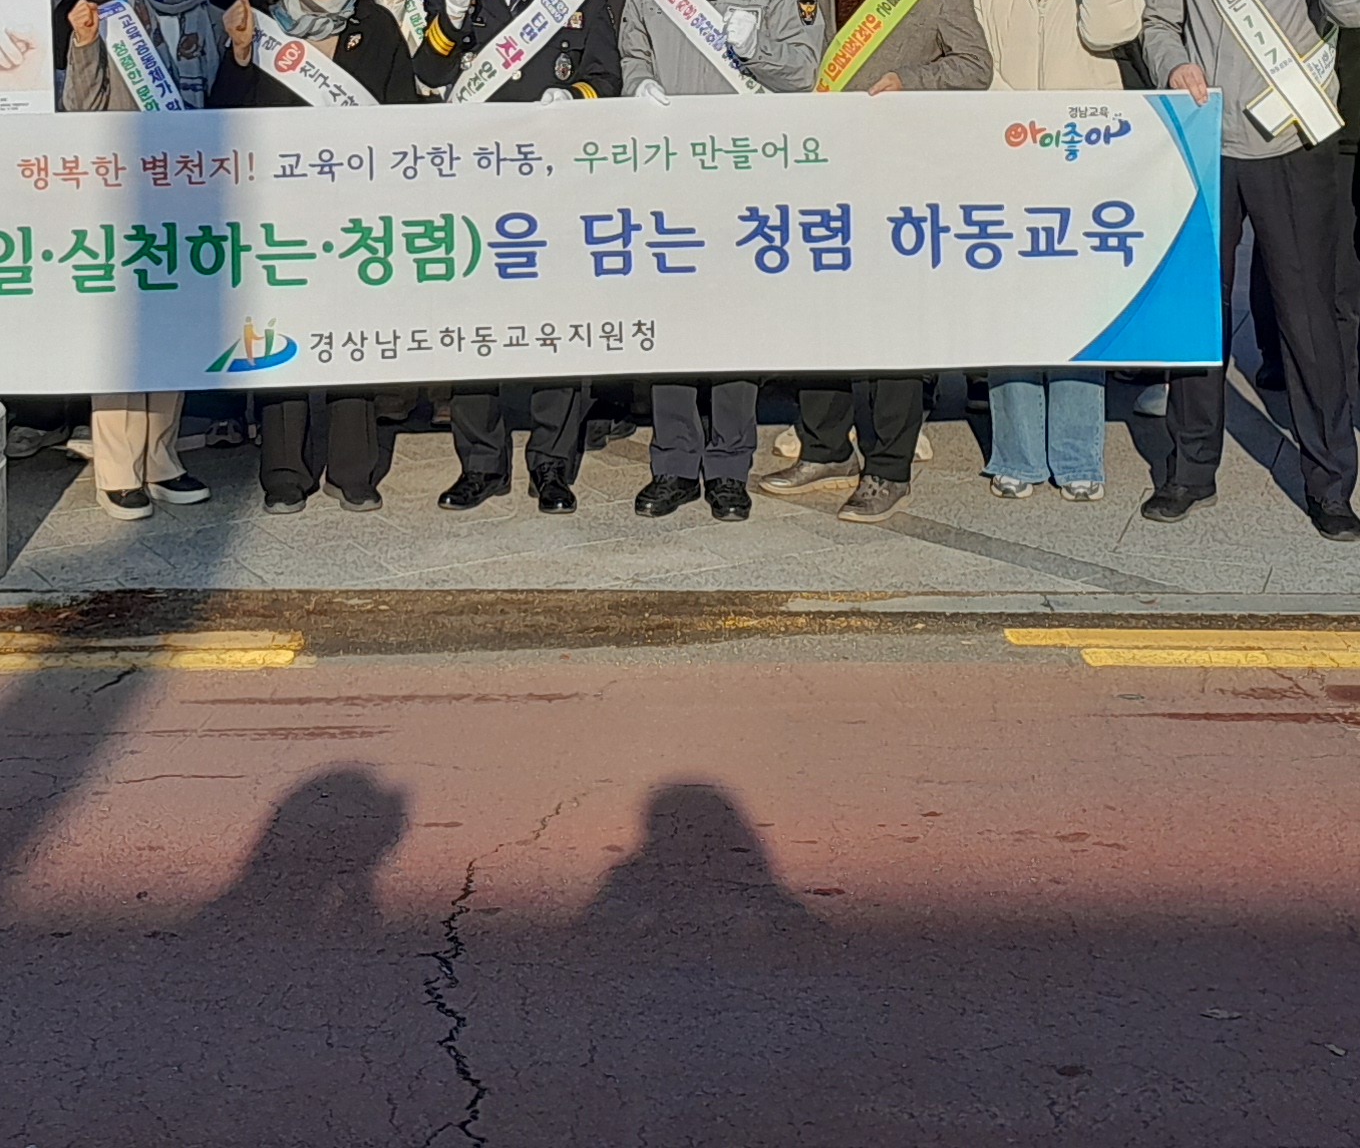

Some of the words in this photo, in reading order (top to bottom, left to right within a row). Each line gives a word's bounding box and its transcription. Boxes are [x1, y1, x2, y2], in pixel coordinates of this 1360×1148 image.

[519, 12, 549, 44] 타면
[824, 14, 884, 82] 안전점검의
[118, 14, 174, 98] 교육공동체가
[280, 42, 302, 71] NO!
[496, 35, 525, 69] 착
[1068, 105, 1110, 119] 경남교육
[1004, 114, 1132, 161] 아이좋아
[17, 152, 127, 190] 행복한
[142, 146, 256, 188] 별천지!
[273, 148, 375, 183] 교육이
[390, 144, 461, 182] 강한
[473, 140, 554, 178] 하동,
[573, 135, 678, 173] 우리가
[690, 132, 829, 172] 만들어요
[580, 207, 705, 277] 담는
[736, 202, 853, 275] 청렴
[887, 199, 1144, 270] 하동교육
[309, 319, 657, 364] 경상남도하동교육지원청
